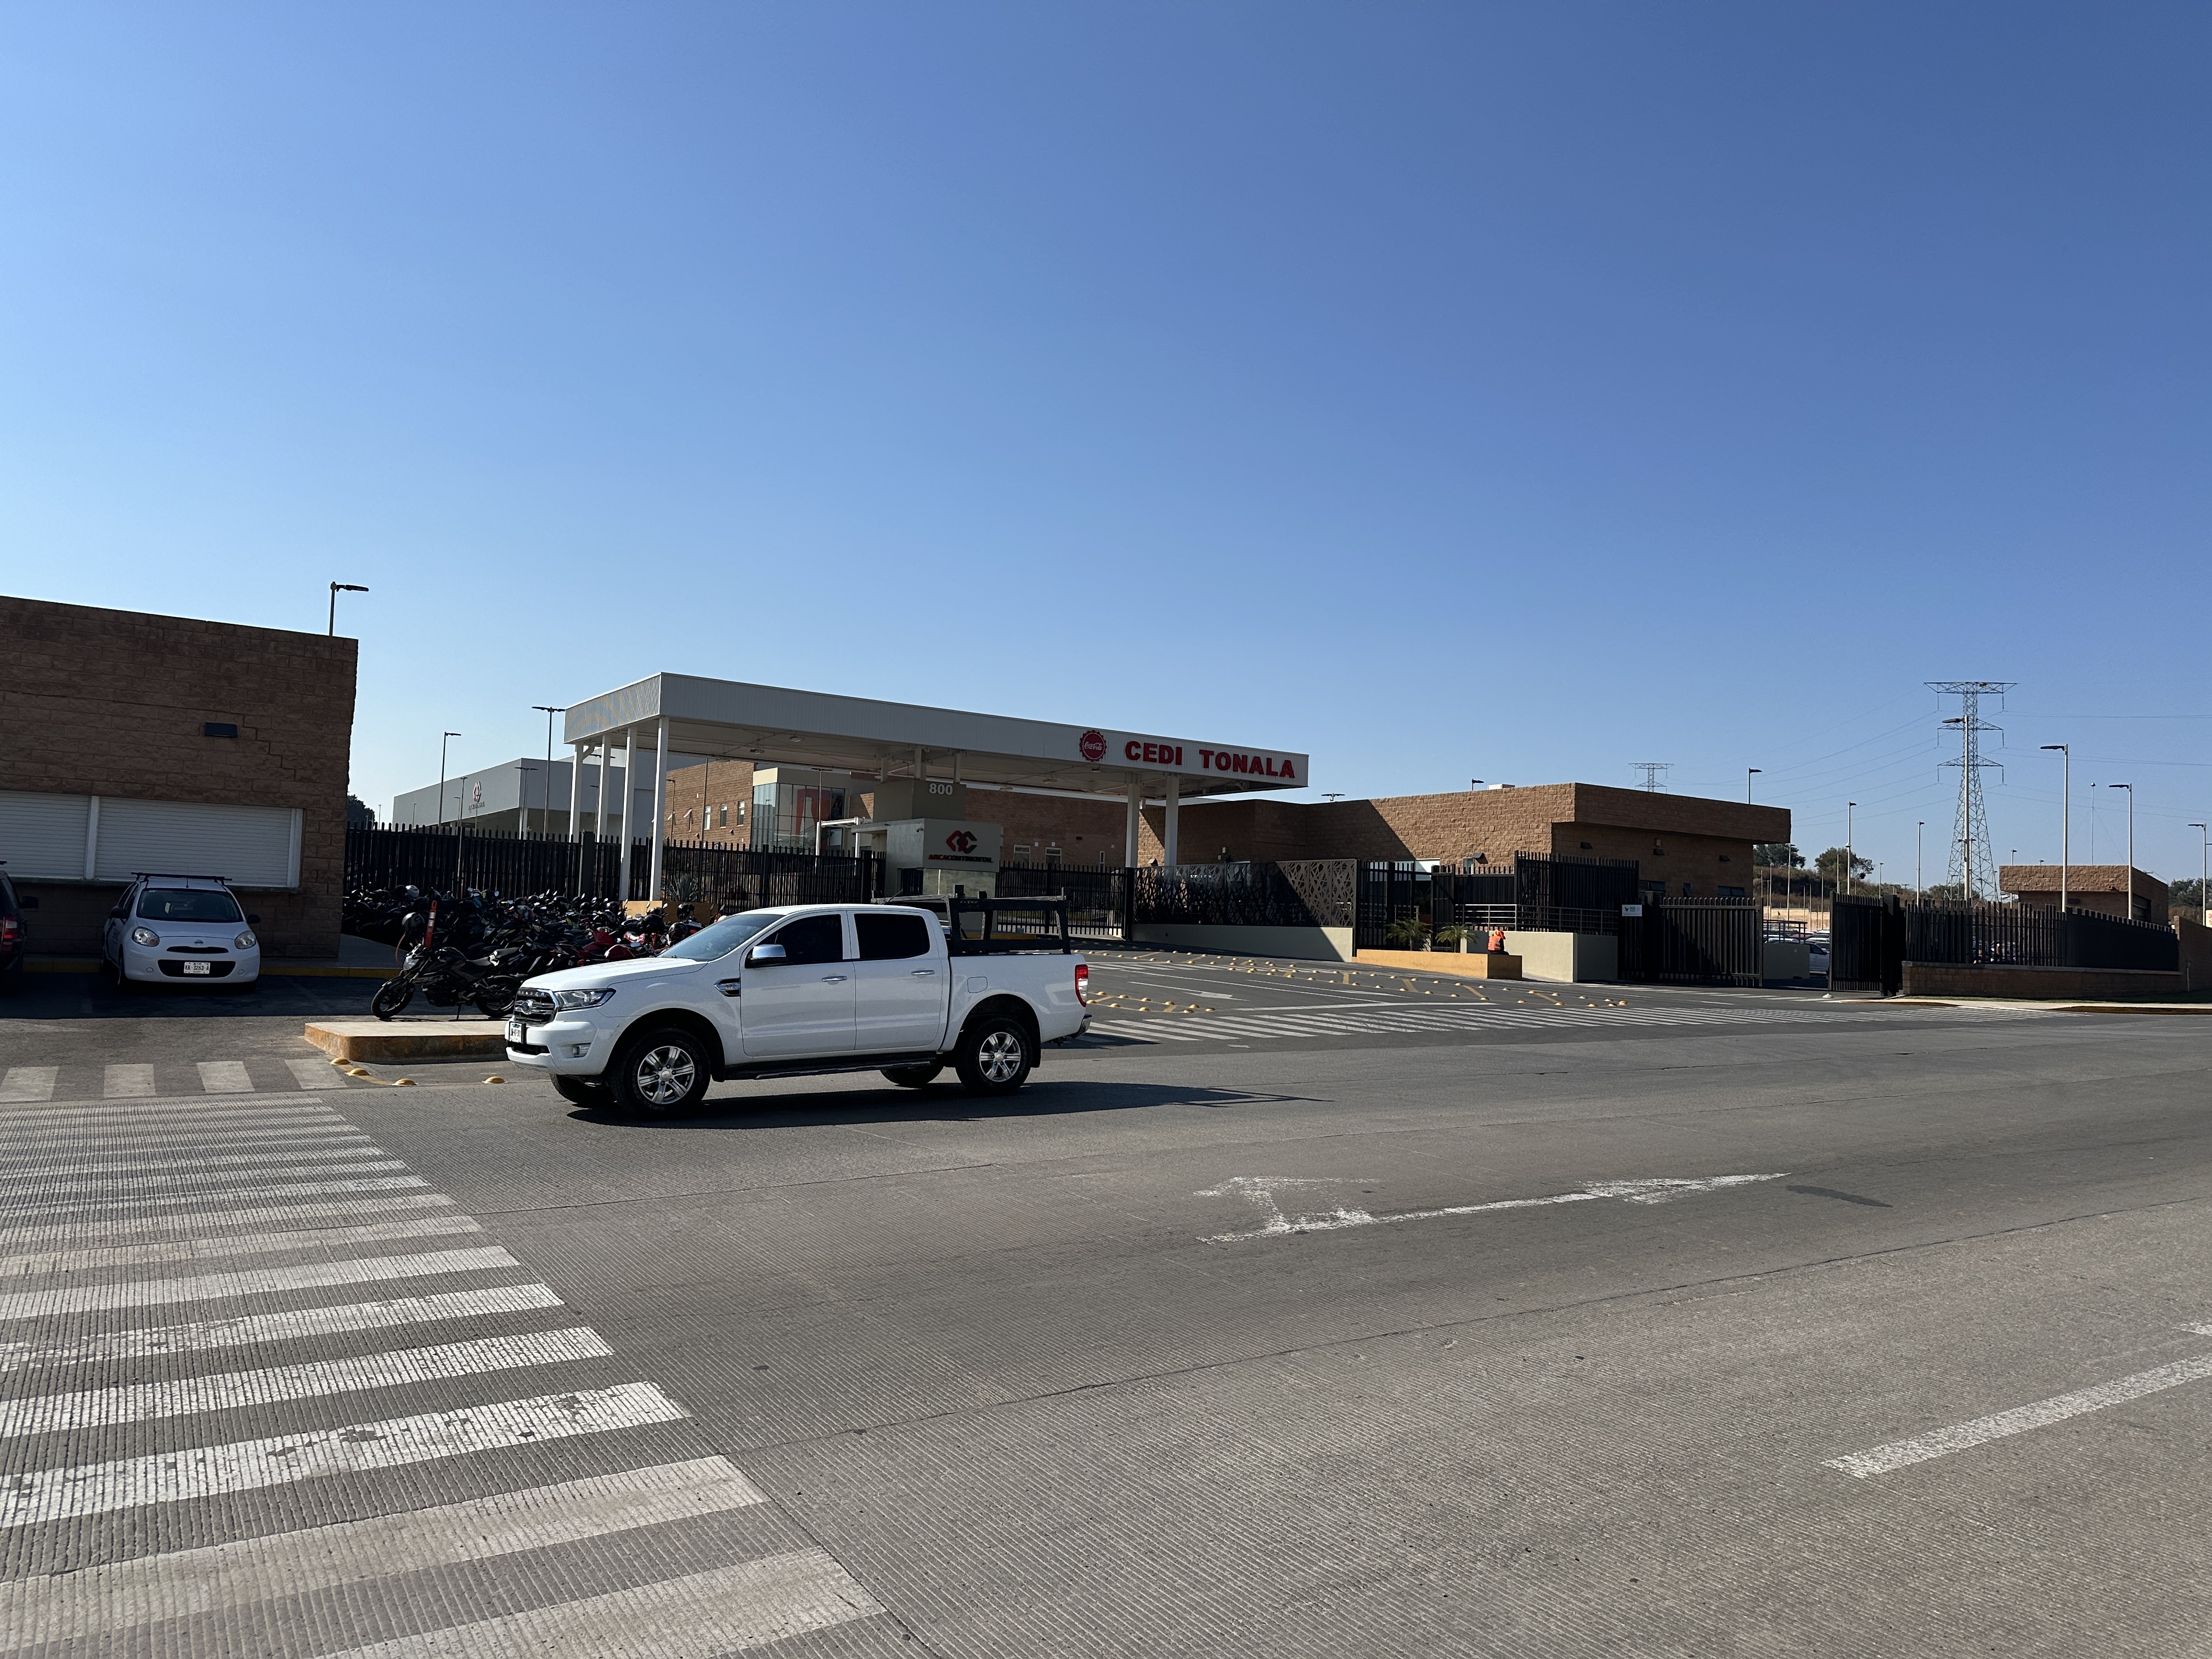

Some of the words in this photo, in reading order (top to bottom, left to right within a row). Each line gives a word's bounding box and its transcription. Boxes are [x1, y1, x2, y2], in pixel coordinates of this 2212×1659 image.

[1125, 741, 1182, 765] CEDI
[1199, 749, 1295, 778] TONALA
[929, 783, 953, 795] 800
